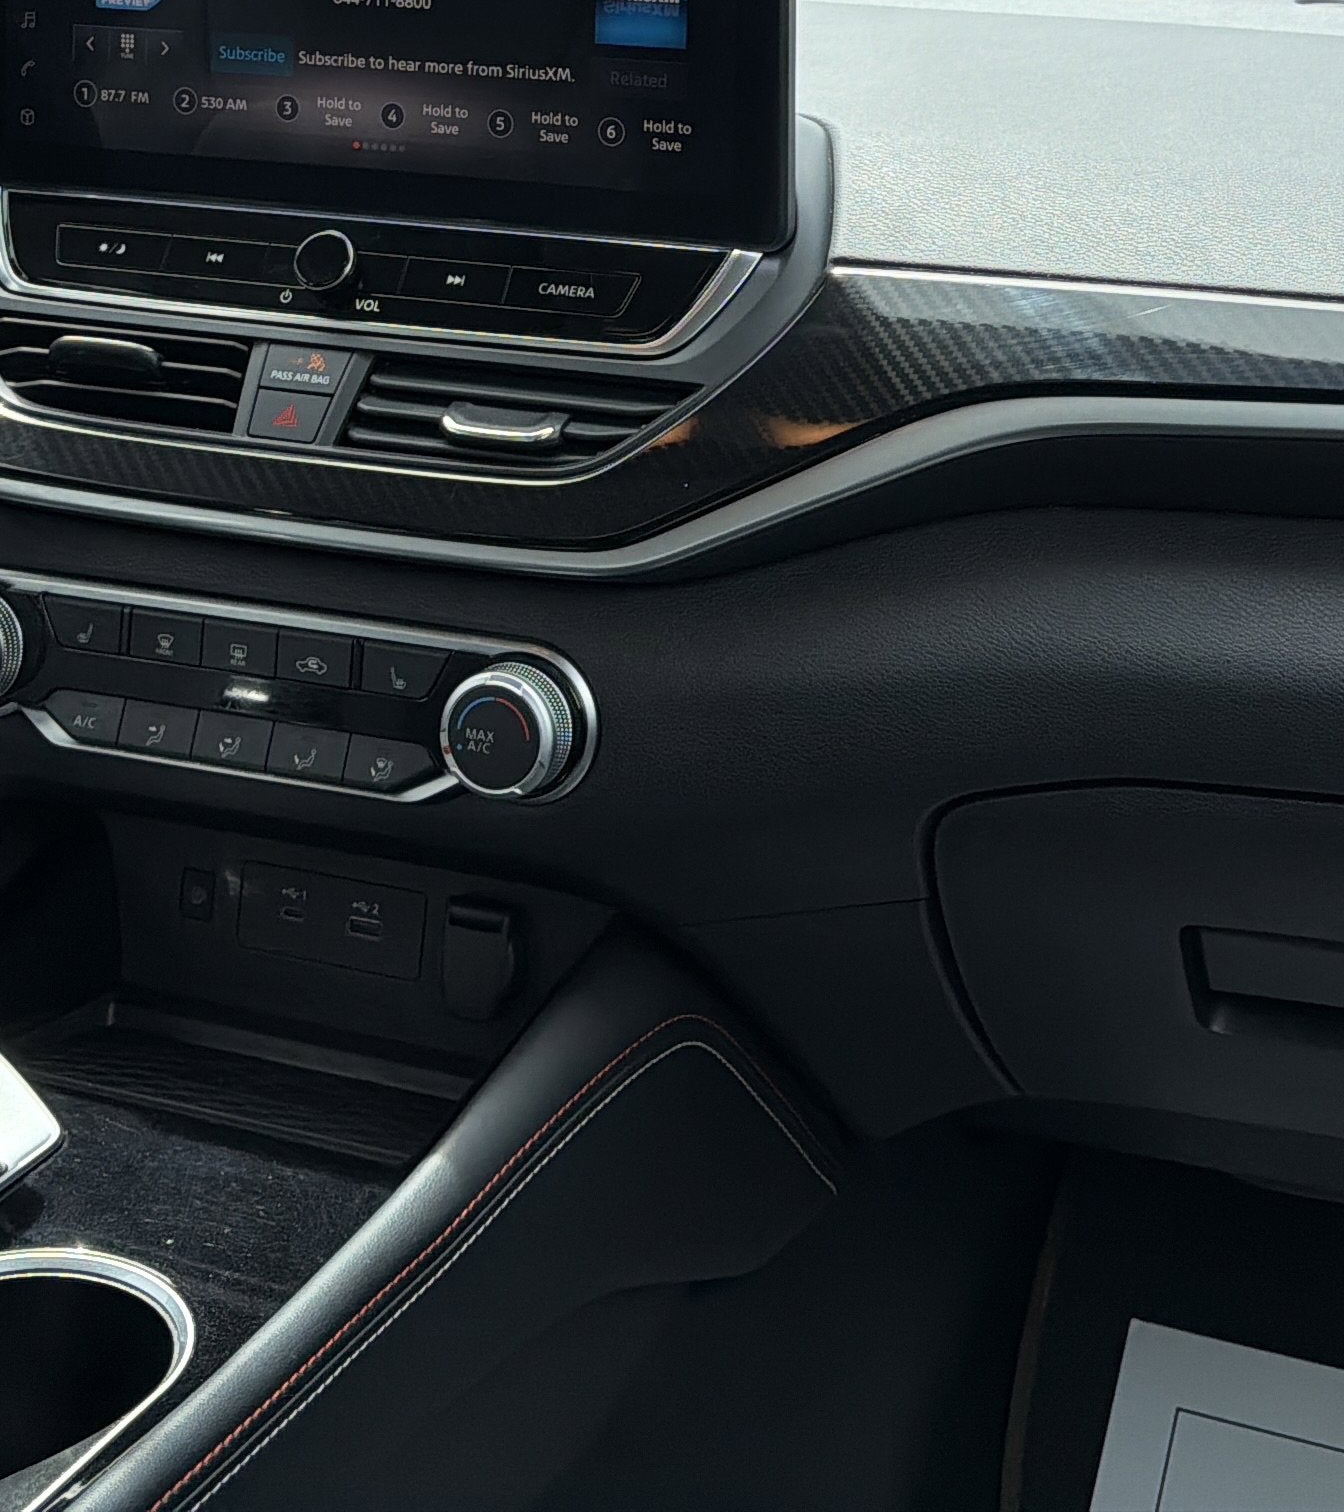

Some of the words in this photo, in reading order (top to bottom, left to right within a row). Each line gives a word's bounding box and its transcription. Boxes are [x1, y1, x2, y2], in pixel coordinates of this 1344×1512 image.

[219, 45, 286, 63] Subscribe
[298, 51, 366, 70] Subscribe
[369, 55, 385, 70] to
[388, 56, 420, 73] hear
[425, 61, 464, 75] more
[466, 60, 503, 78] from
[505, 64, 576, 83] SiriusXM.
[610, 70, 669, 88] Related
[100, 89, 126, 103] 87.7
[131, 90, 150, 104] FM
[201, 96, 223, 110] 530
[225, 97, 248, 111] AM
[316, 96, 344, 110] Hold
[347, 98, 361, 111] to
[422, 103, 450, 118] Hold
[454, 106, 469, 120] to
[324, 113, 353, 128] Save
[531, 111, 561, 126] Hold
[564, 114, 579, 128] to
[430, 121, 459, 136] Save
[643, 119, 675, 134] Hold
[677, 122, 692, 136] to
[539, 129, 569, 144] Save
[651, 137, 682, 152] Save
[538, 282, 595, 299] CAMERA
[355, 298, 380, 313] VOL
[270, 369, 294, 383] PASS
[293, 372, 310, 384] AIR
[311, 373, 331, 385] BAG
[73, 714, 97, 729] A/C
[465, 727, 495, 744] MAX
[467, 740, 491, 755] A/C
